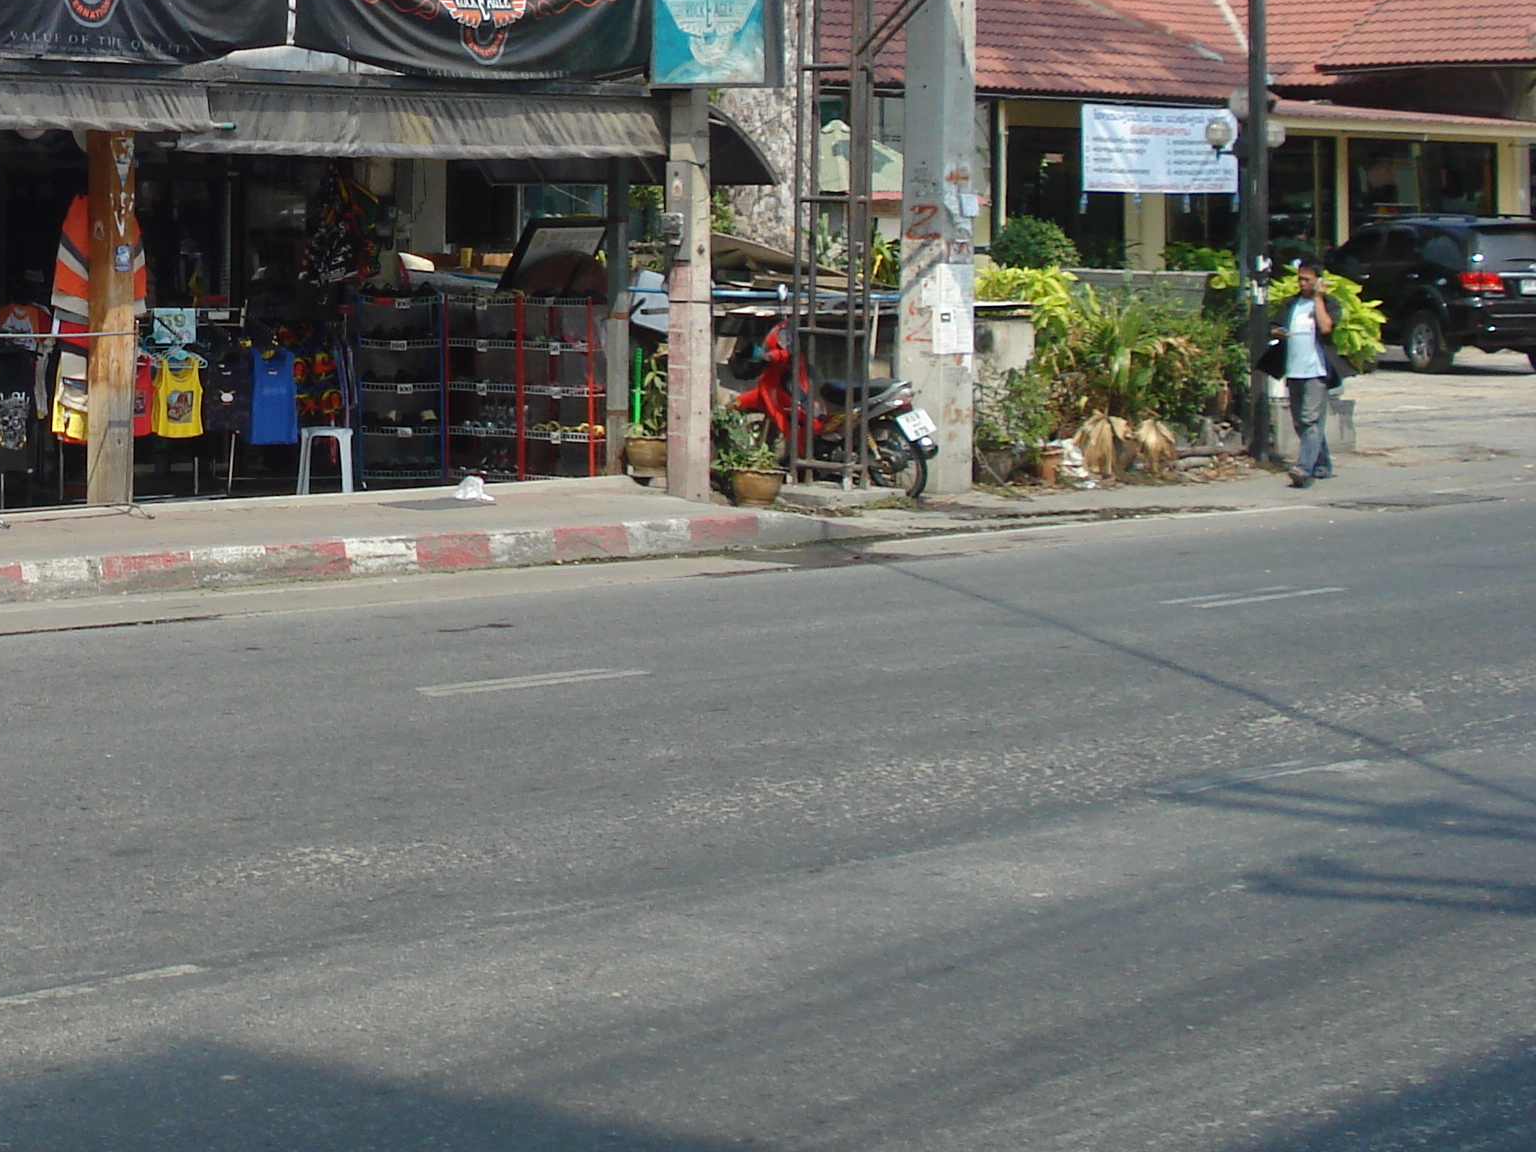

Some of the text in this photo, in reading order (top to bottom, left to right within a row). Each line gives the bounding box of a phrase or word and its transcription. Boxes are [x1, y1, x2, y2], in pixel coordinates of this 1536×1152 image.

[10, 30, 62, 43] VALUE
[68, 34, 90, 45] OF
[98, 35, 123, 48] THE
